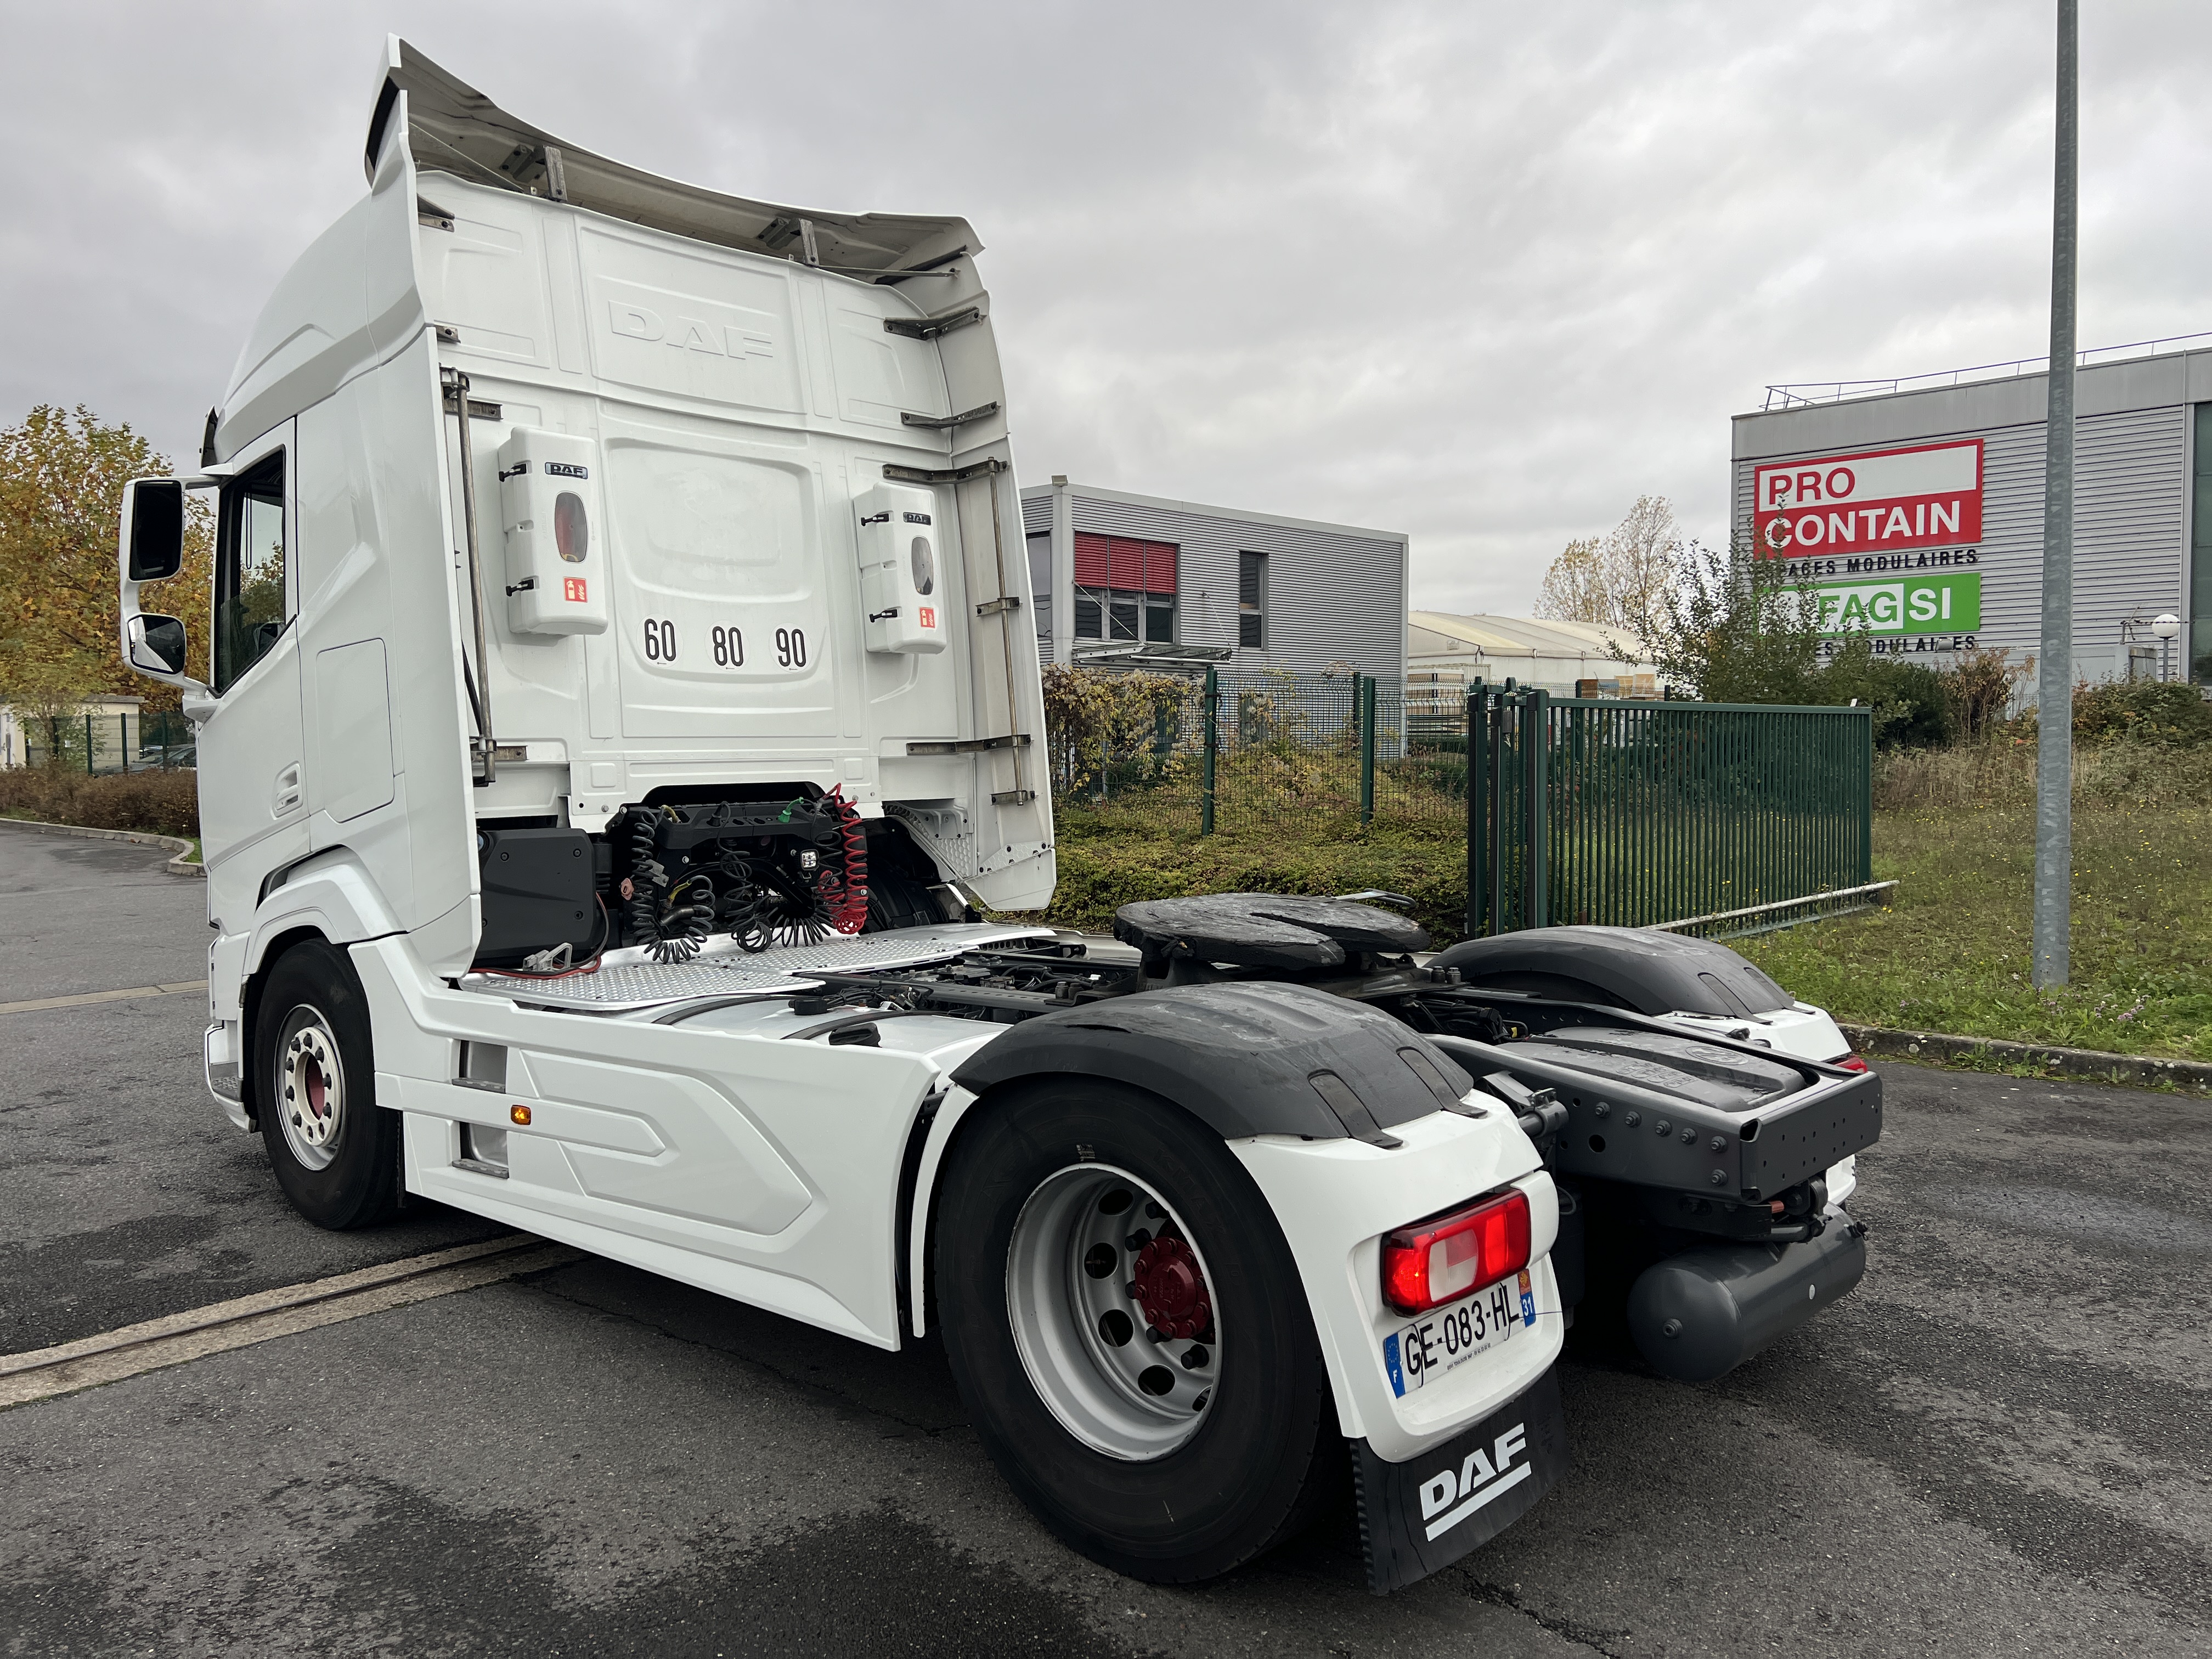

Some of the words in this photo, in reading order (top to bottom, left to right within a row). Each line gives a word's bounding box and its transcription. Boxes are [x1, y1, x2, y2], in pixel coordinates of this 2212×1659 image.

[608, 300, 773, 360] DAF
[550, 464, 583, 475] DAF
[1768, 467, 1855, 505] PRO
[906, 514, 928, 523] DAF
[1765, 500, 1960, 549] CONTAIN
[1847, 549, 1976, 572] MODULAIRES
[1818, 587, 1950, 626] FAGSI
[644, 618, 676, 662] 60
[712, 626, 744, 667] 80
[775, 628, 806, 668] 90
[1522, 1296, 1533, 1316] 31
[1406, 1285, 1519, 1375] GE-083-HL
[1393, 1369, 1398, 1383] F
[1420, 1423, 1526, 1521] DAF
